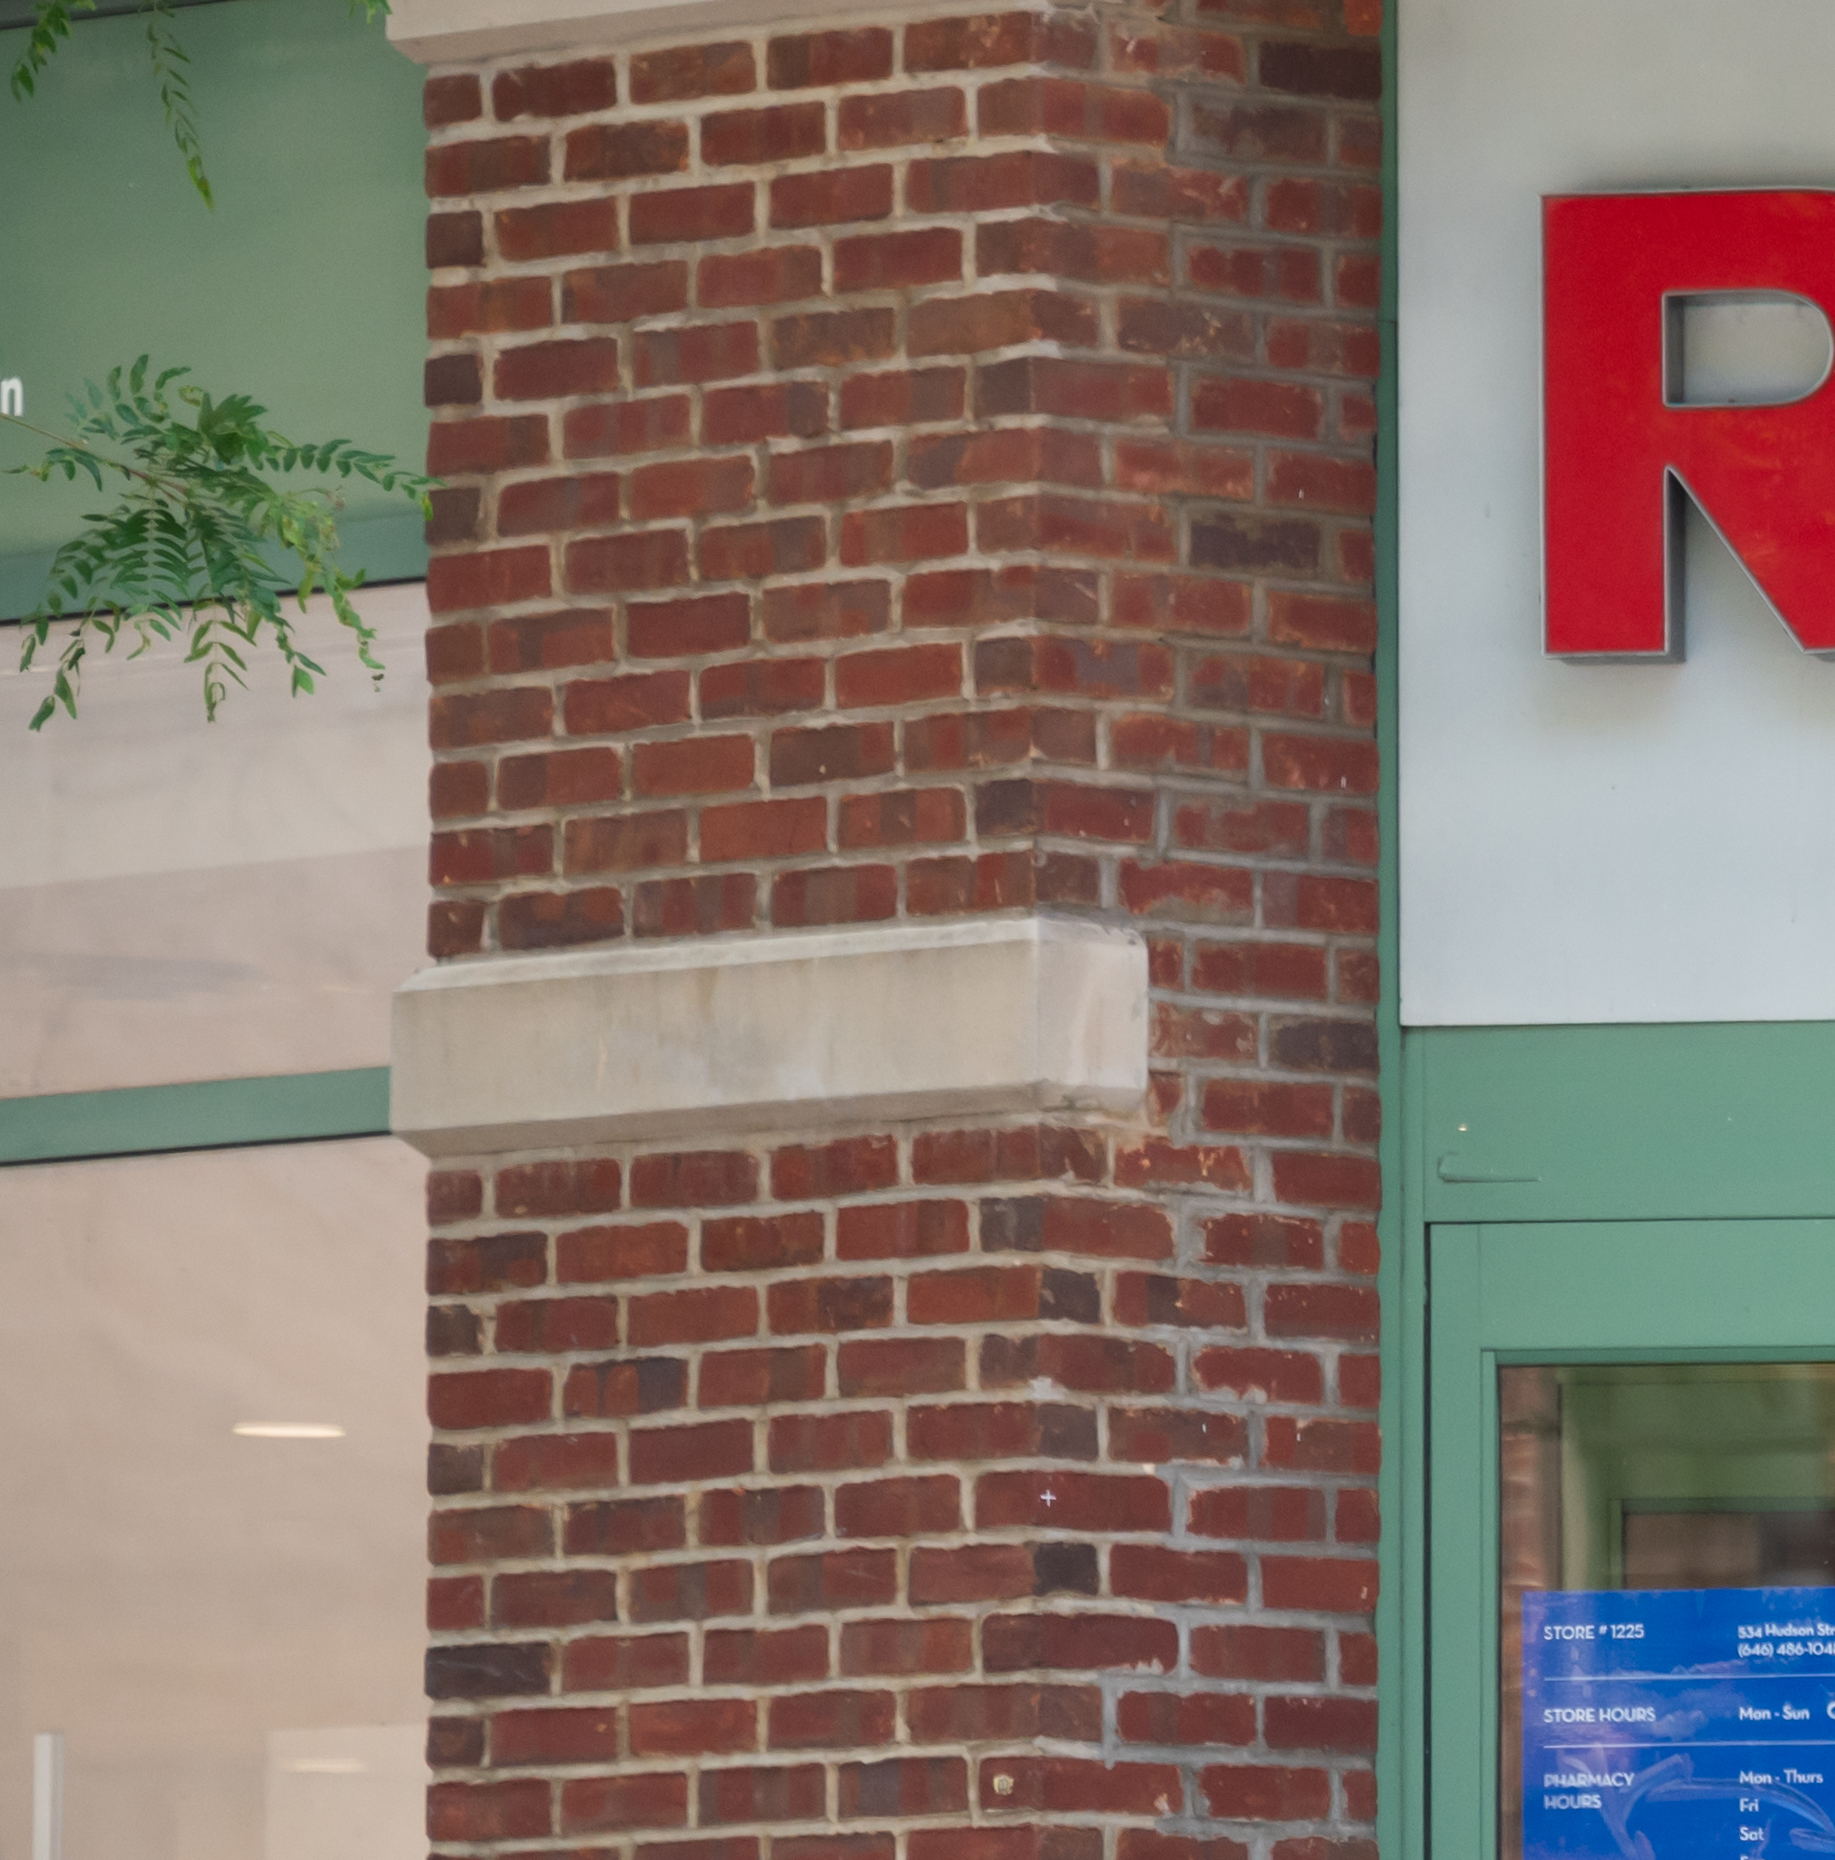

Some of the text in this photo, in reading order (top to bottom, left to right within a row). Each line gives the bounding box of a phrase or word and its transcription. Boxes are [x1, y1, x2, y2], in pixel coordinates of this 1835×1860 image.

[1544, 1624, 1595, 1641] STORE
[1610, 1623, 1645, 1639] 1225
[1738, 1625, 1763, 1640] 534
[1765, 1622, 1814, 1637] Hudson
[1738, 1641, 1774, 1658] (646)
[1544, 1706, 1656, 1723] STORE HOURS
[1739, 1706, 1772, 1721] Mon
[1782, 1702, 1811, 1721] Sun
[1544, 1772, 1635, 1788] PHARMACY
[1739, 1770, 1773, 1785] Mon
[1783, 1768, 1824, 1784] Thurs
[1544, 1793, 1602, 1810] HOURS
[1739, 1798, 1760, 1813] Fri
[1739, 1825, 1765, 1841] Sat
